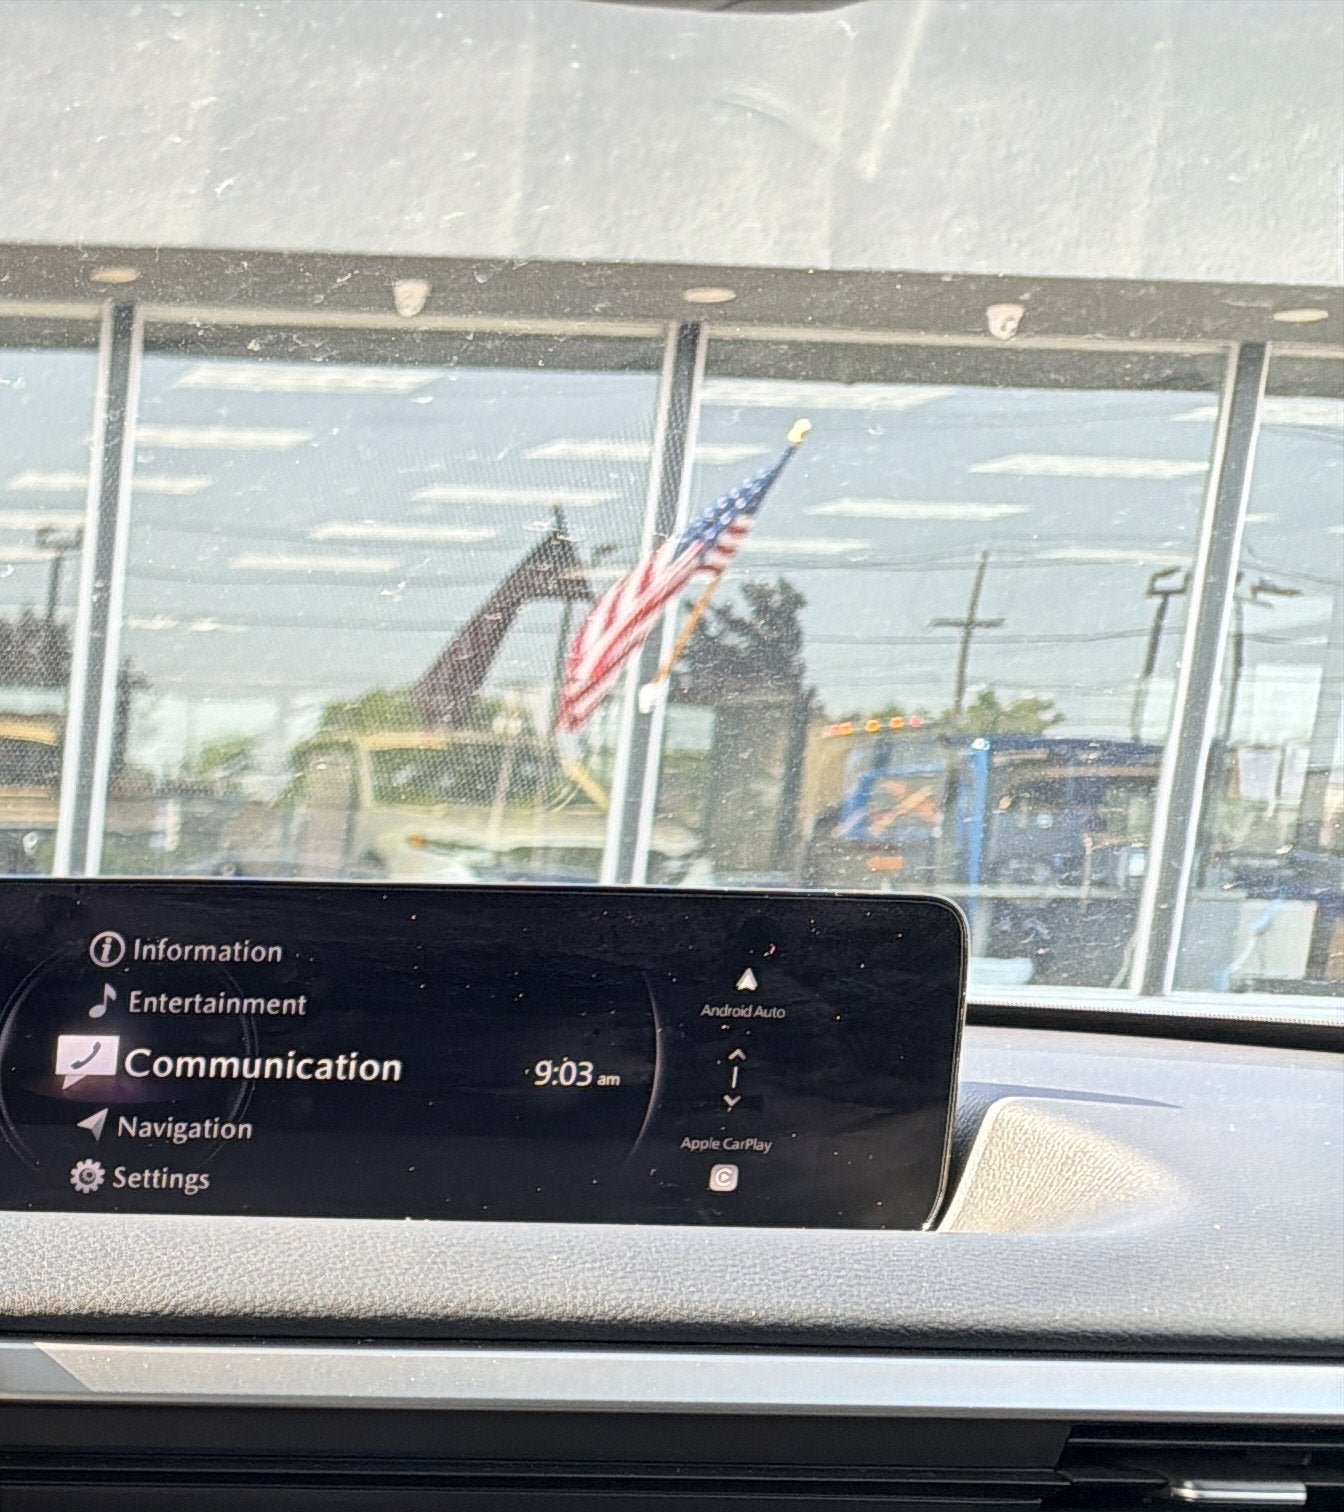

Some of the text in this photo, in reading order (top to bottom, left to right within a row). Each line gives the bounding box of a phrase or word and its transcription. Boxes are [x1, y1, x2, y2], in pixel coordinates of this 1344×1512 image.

[132, 938, 282, 963] Information
[129, 990, 307, 1016] Entertainment
[701, 1003, 786, 1018] Android Auto
[124, 1048, 402, 1082] Communication
[534, 1056, 621, 1087] 9:03 am
[117, 1115, 253, 1145] Navigation
[680, 1136, 773, 1155] Apple CarPlay
[112, 1166, 210, 1196] Settings
